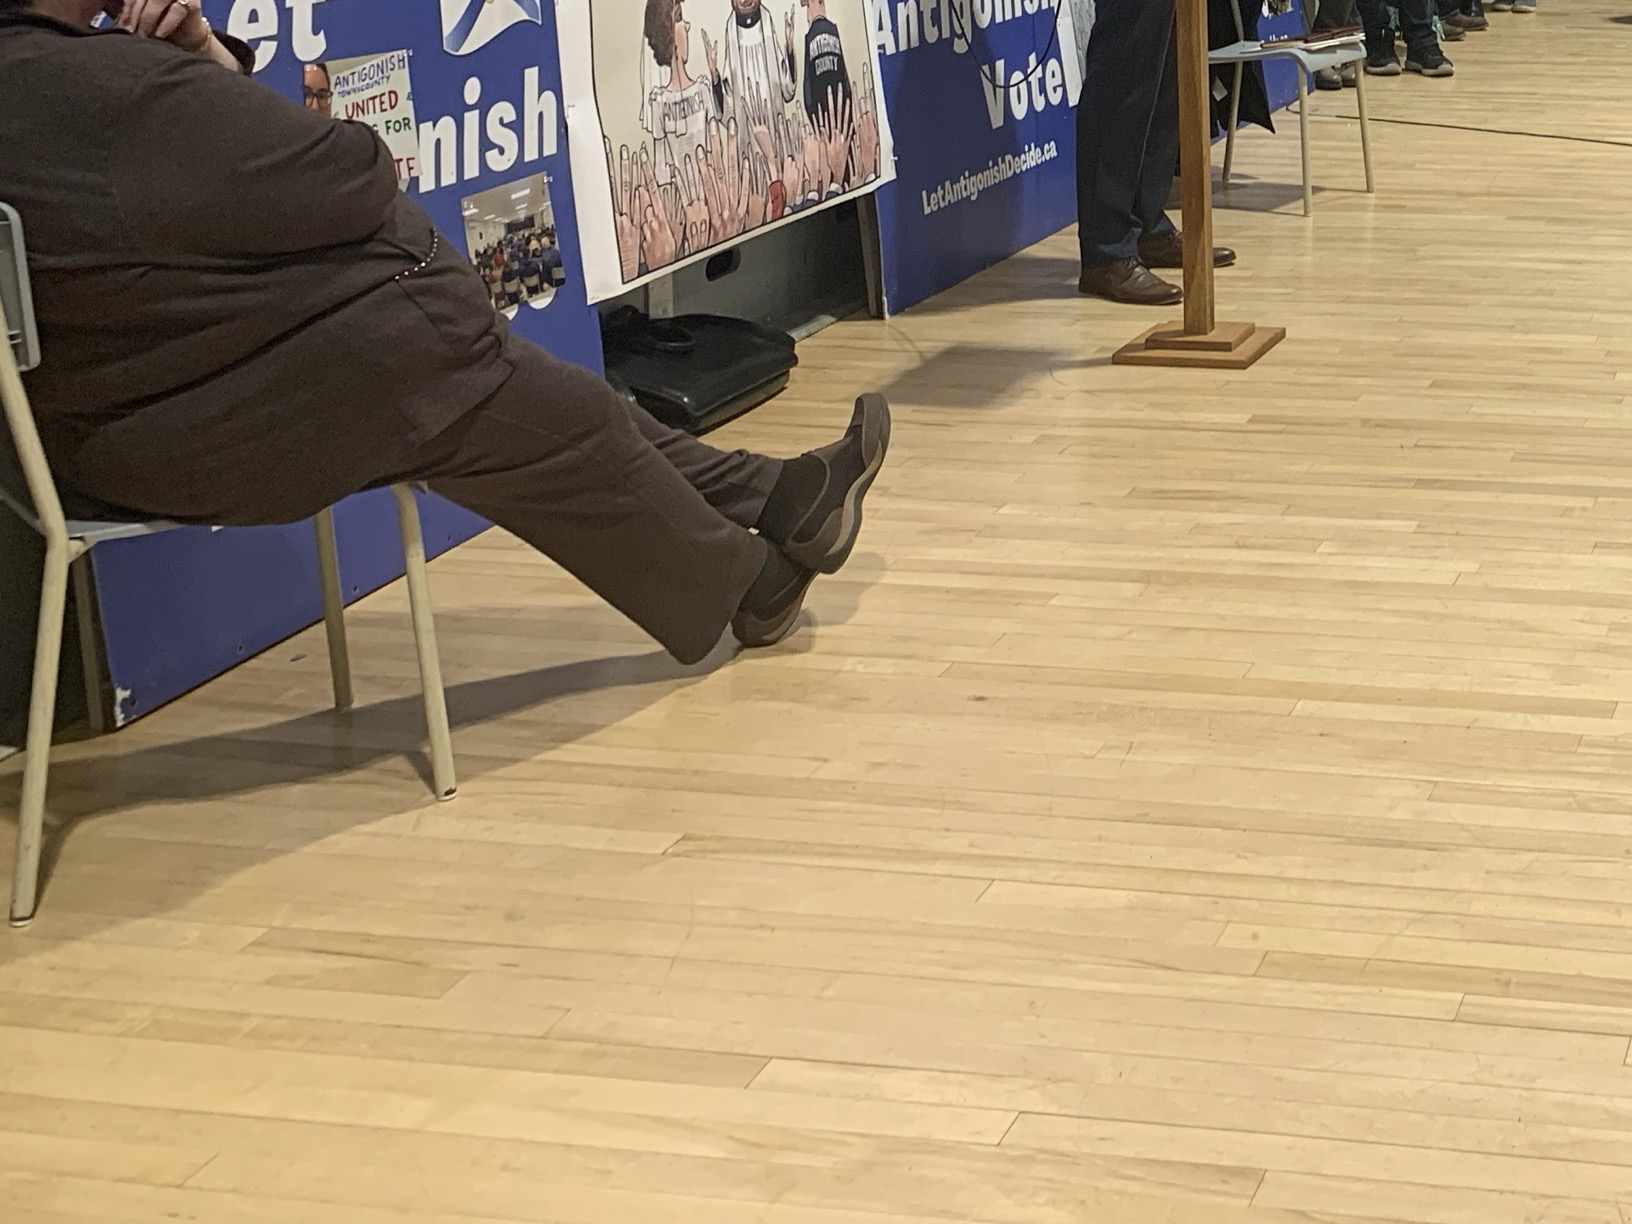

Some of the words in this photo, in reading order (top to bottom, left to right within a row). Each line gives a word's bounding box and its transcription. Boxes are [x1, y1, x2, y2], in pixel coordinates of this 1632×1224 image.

[333, 52, 406, 90] ANTIGONISH
[345, 90, 399, 119] UNITED
[979, 51, 1064, 131] Vote
[384, 117, 412, 135] FOR
[922, 140, 1058, 216] LetAntigonishDecide.ca
